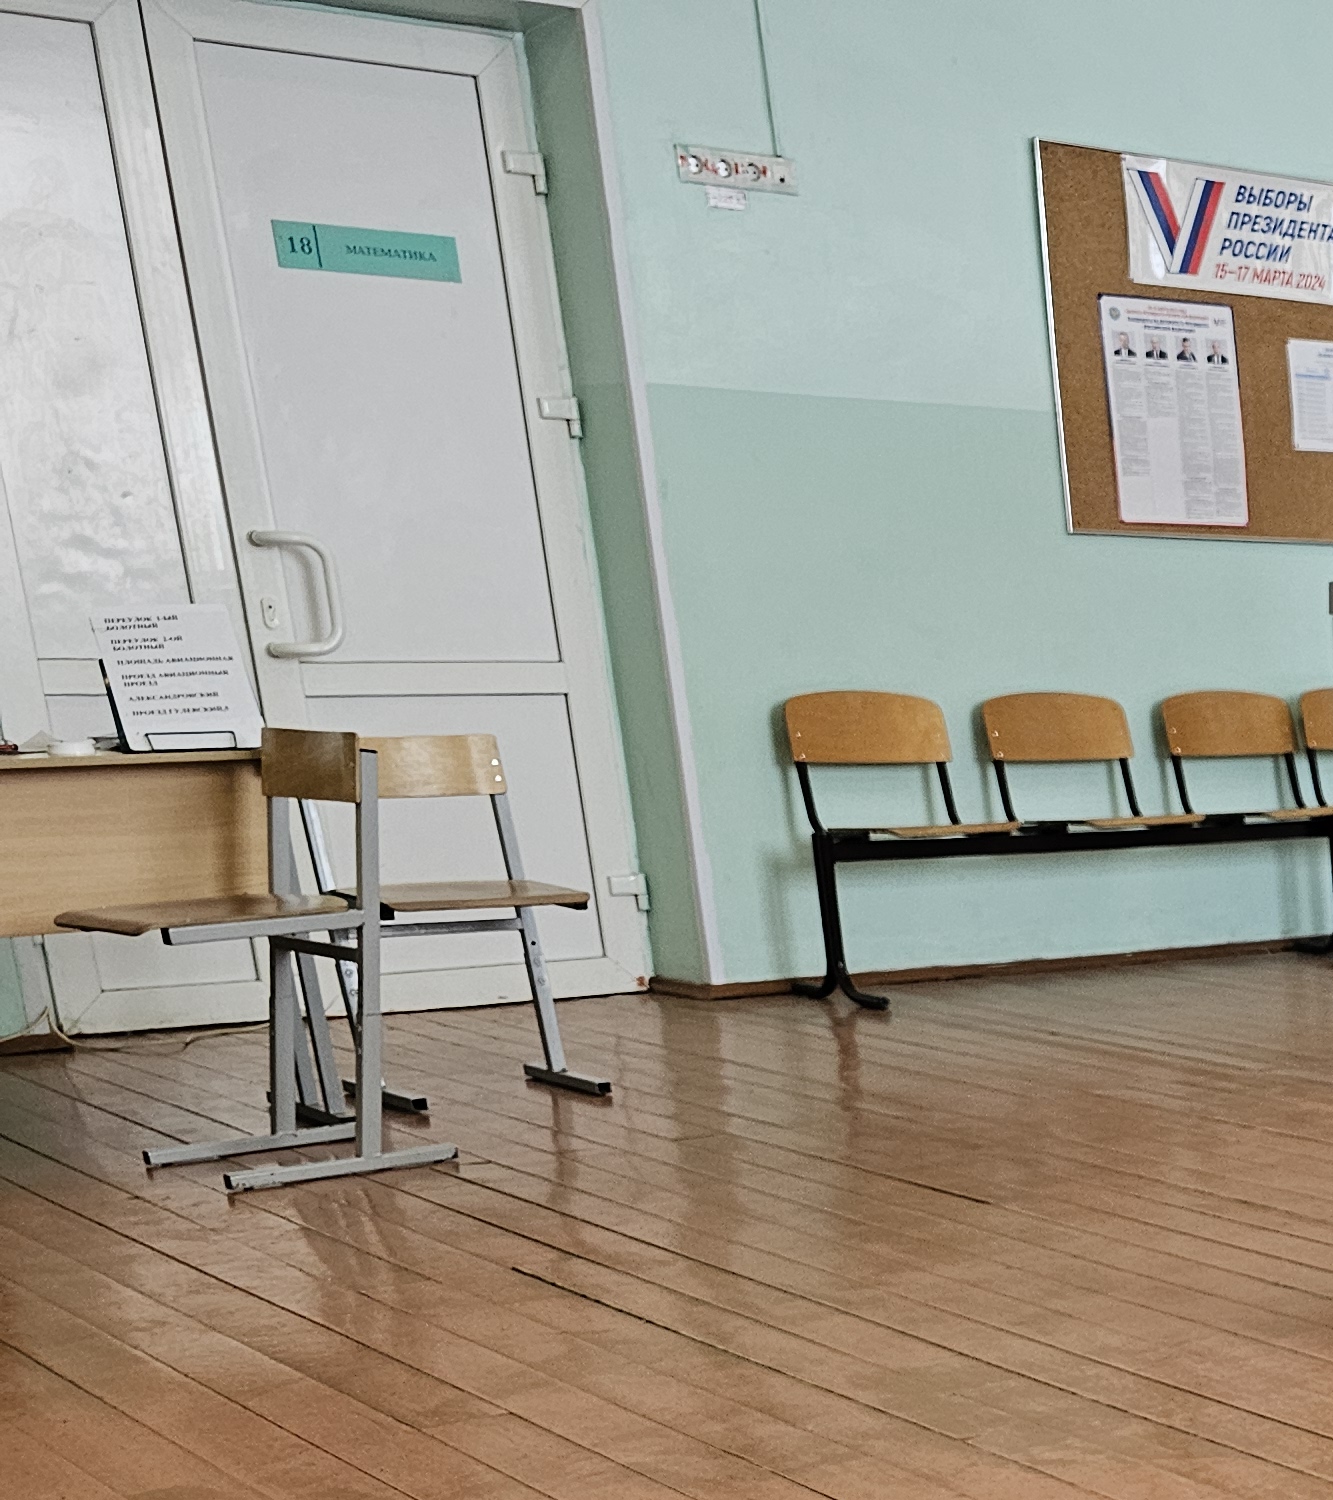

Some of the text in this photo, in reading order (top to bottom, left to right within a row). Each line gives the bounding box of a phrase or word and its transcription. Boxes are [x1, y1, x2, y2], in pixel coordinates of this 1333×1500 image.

[1234, 184, 1314, 213] ВЫБОРЫ
[287, 235, 438, 262] 18 МАТЕМАТИКА
[1219, 237, 1293, 264] РОССИИ
[1251, 268, 1294, 287] МАРТА
[1295, 273, 1326, 291] 2024
